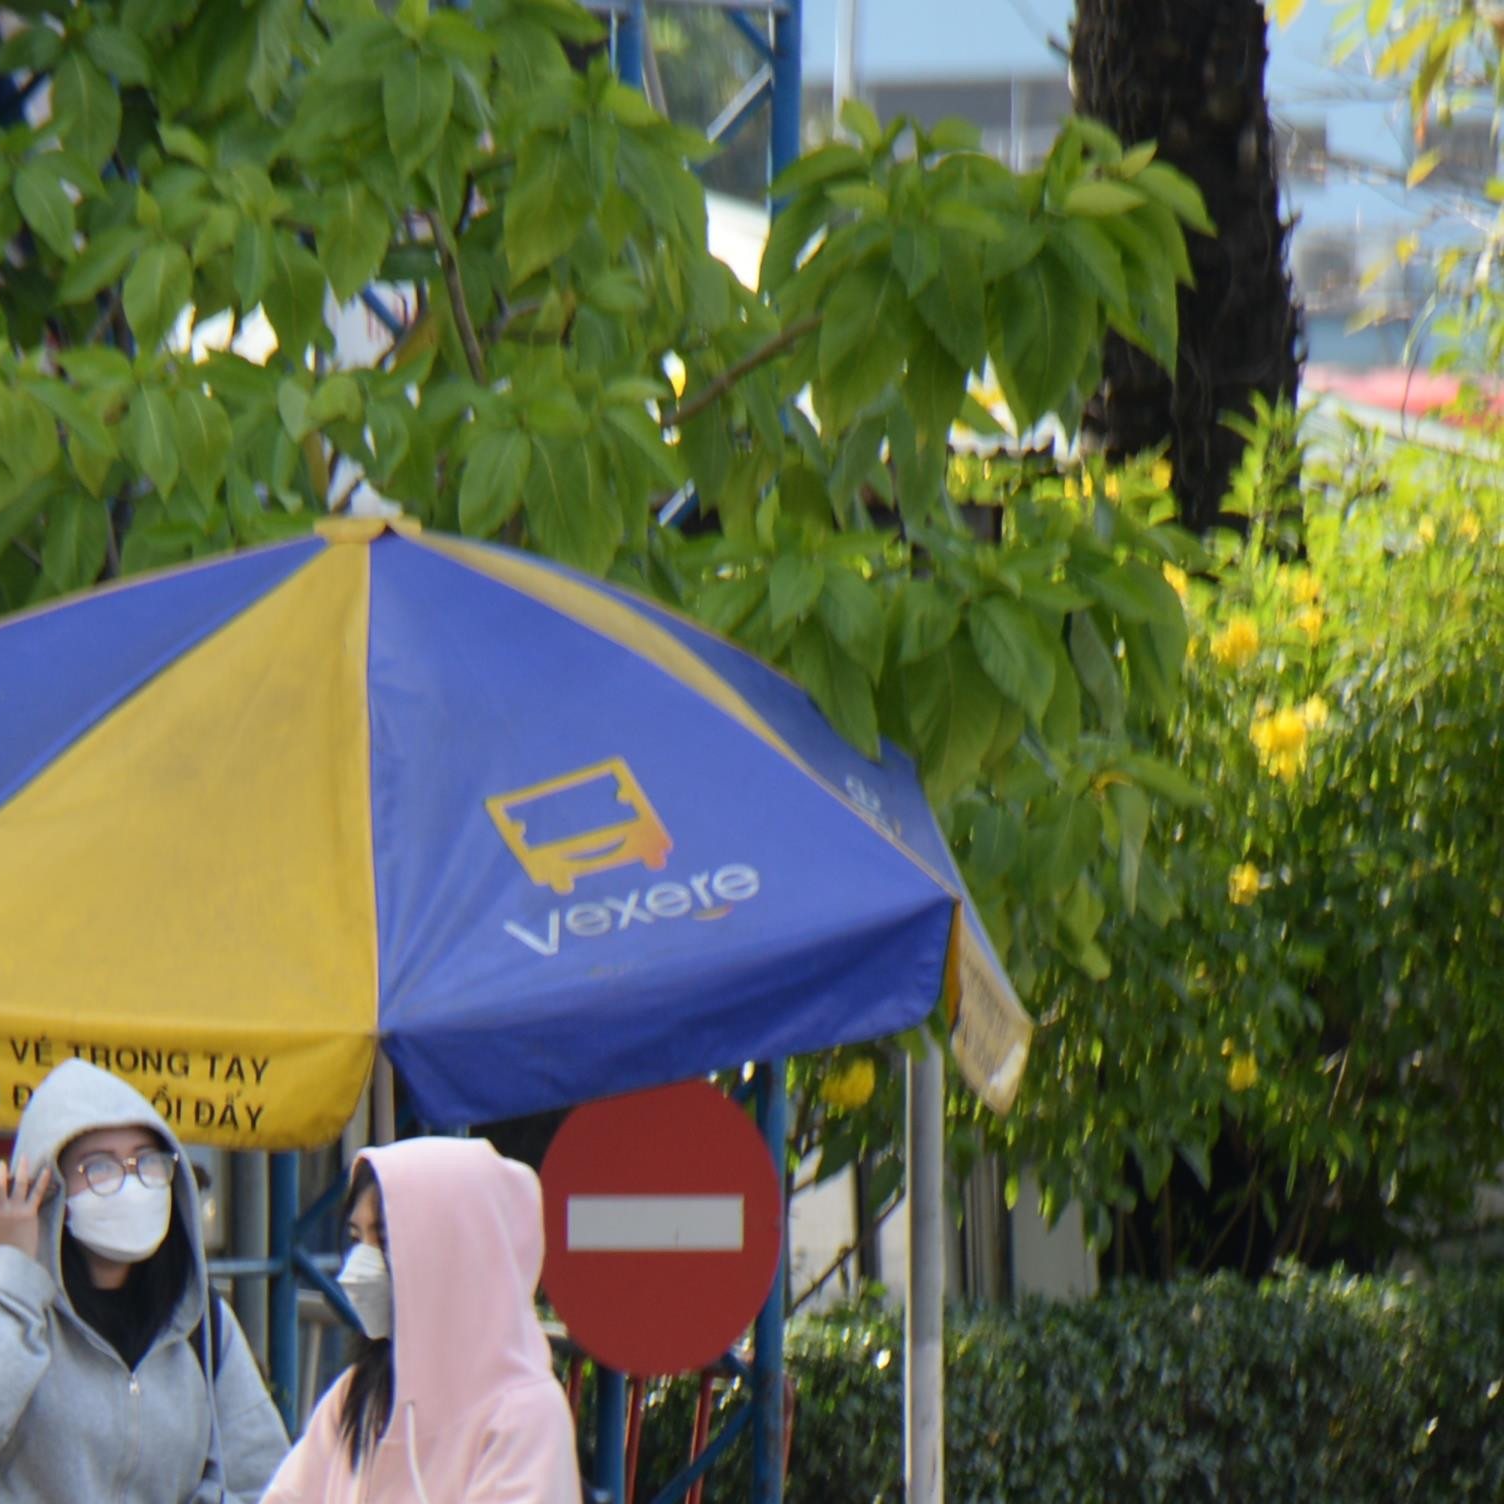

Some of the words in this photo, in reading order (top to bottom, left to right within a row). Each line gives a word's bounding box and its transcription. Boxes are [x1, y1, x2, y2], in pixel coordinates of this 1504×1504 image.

[503, 863, 760, 957] Vexere
[65, 1042, 190, 1079] TRONG
[203, 1051, 271, 1086] TAY
[194, 1087, 265, 1131] ĐẤY
